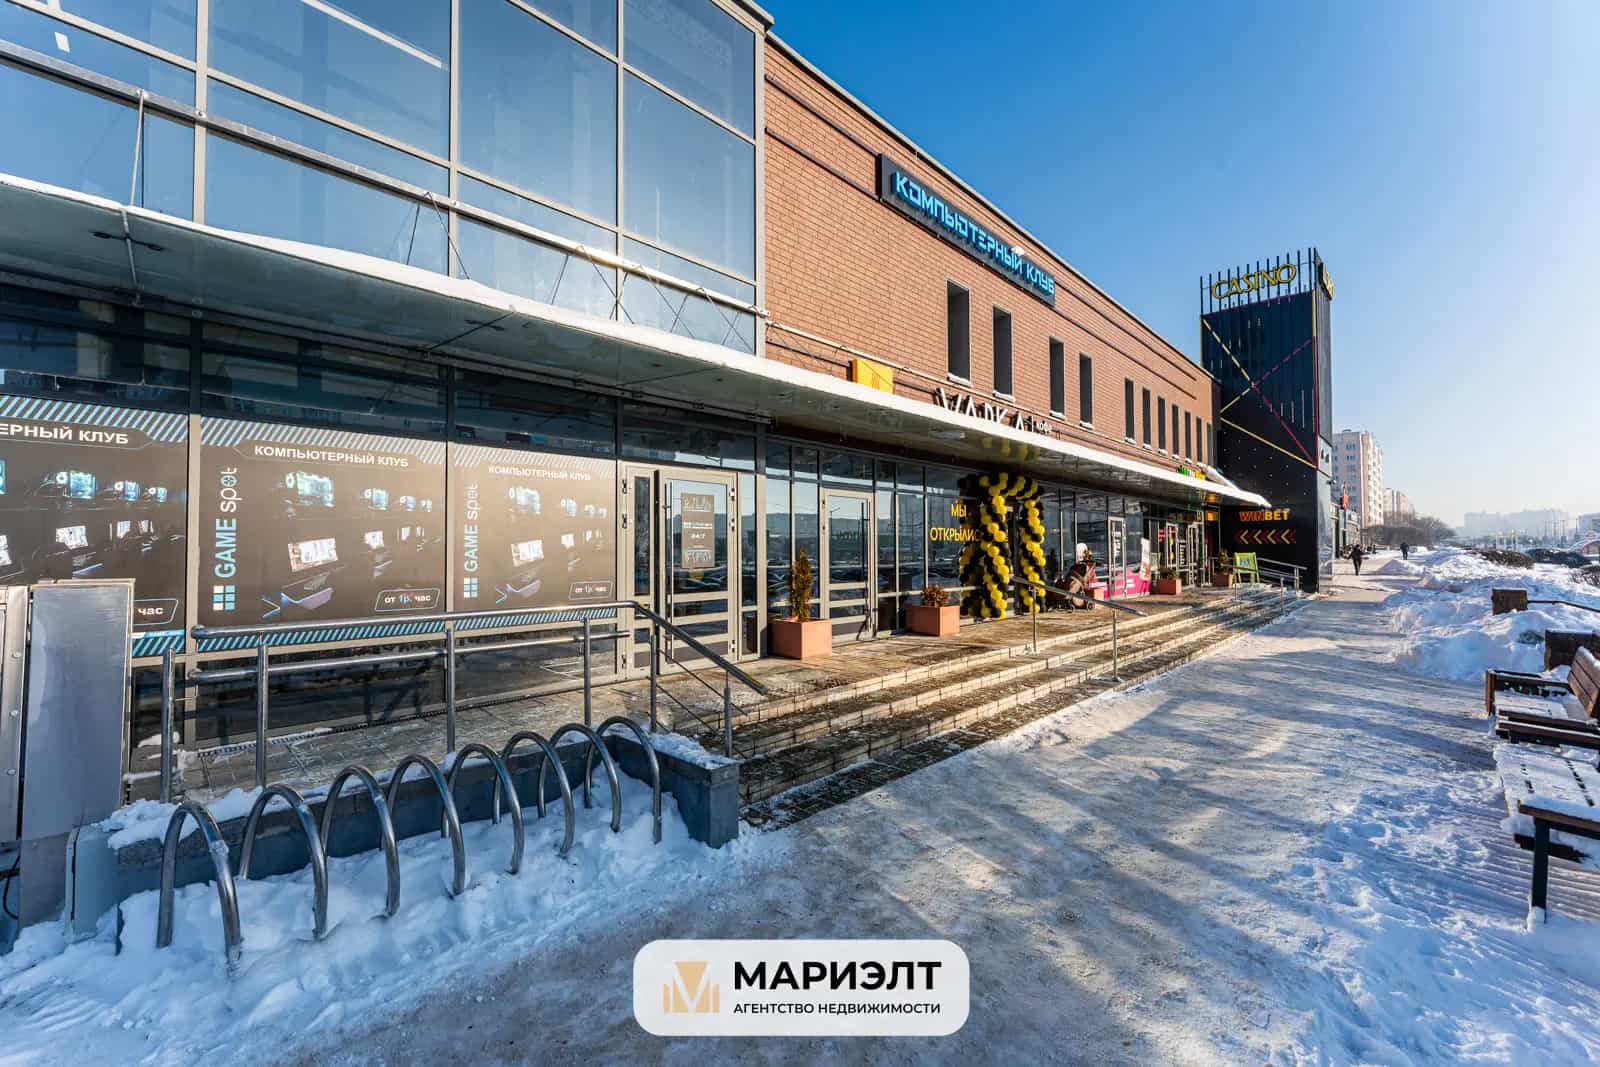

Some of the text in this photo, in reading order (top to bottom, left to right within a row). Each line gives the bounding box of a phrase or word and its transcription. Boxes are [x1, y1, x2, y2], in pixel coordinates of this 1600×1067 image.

[894, 171, 1055, 294] КОМПЬЮТЕРНЫЙ КЛУБ
[1211, 263, 1297, 300] CASINO
[0, 423, 129, 444] ЕРНЫЙ КЛУБ
[254, 445, 409, 467] КОМПЬЮТЕРНЫЙ КЛУБ
[488, 465, 591, 481] КОМПЬЮТЕРНЫЙ КЛУБ
[951, 503, 967, 518] МЫ
[1238, 508, 1290, 521] WINBET
[214, 466, 242, 578] GAME spot
[463, 524, 479, 572] GAME
[384, 596, 396, 604] от
[138, 607, 164, 616] час
